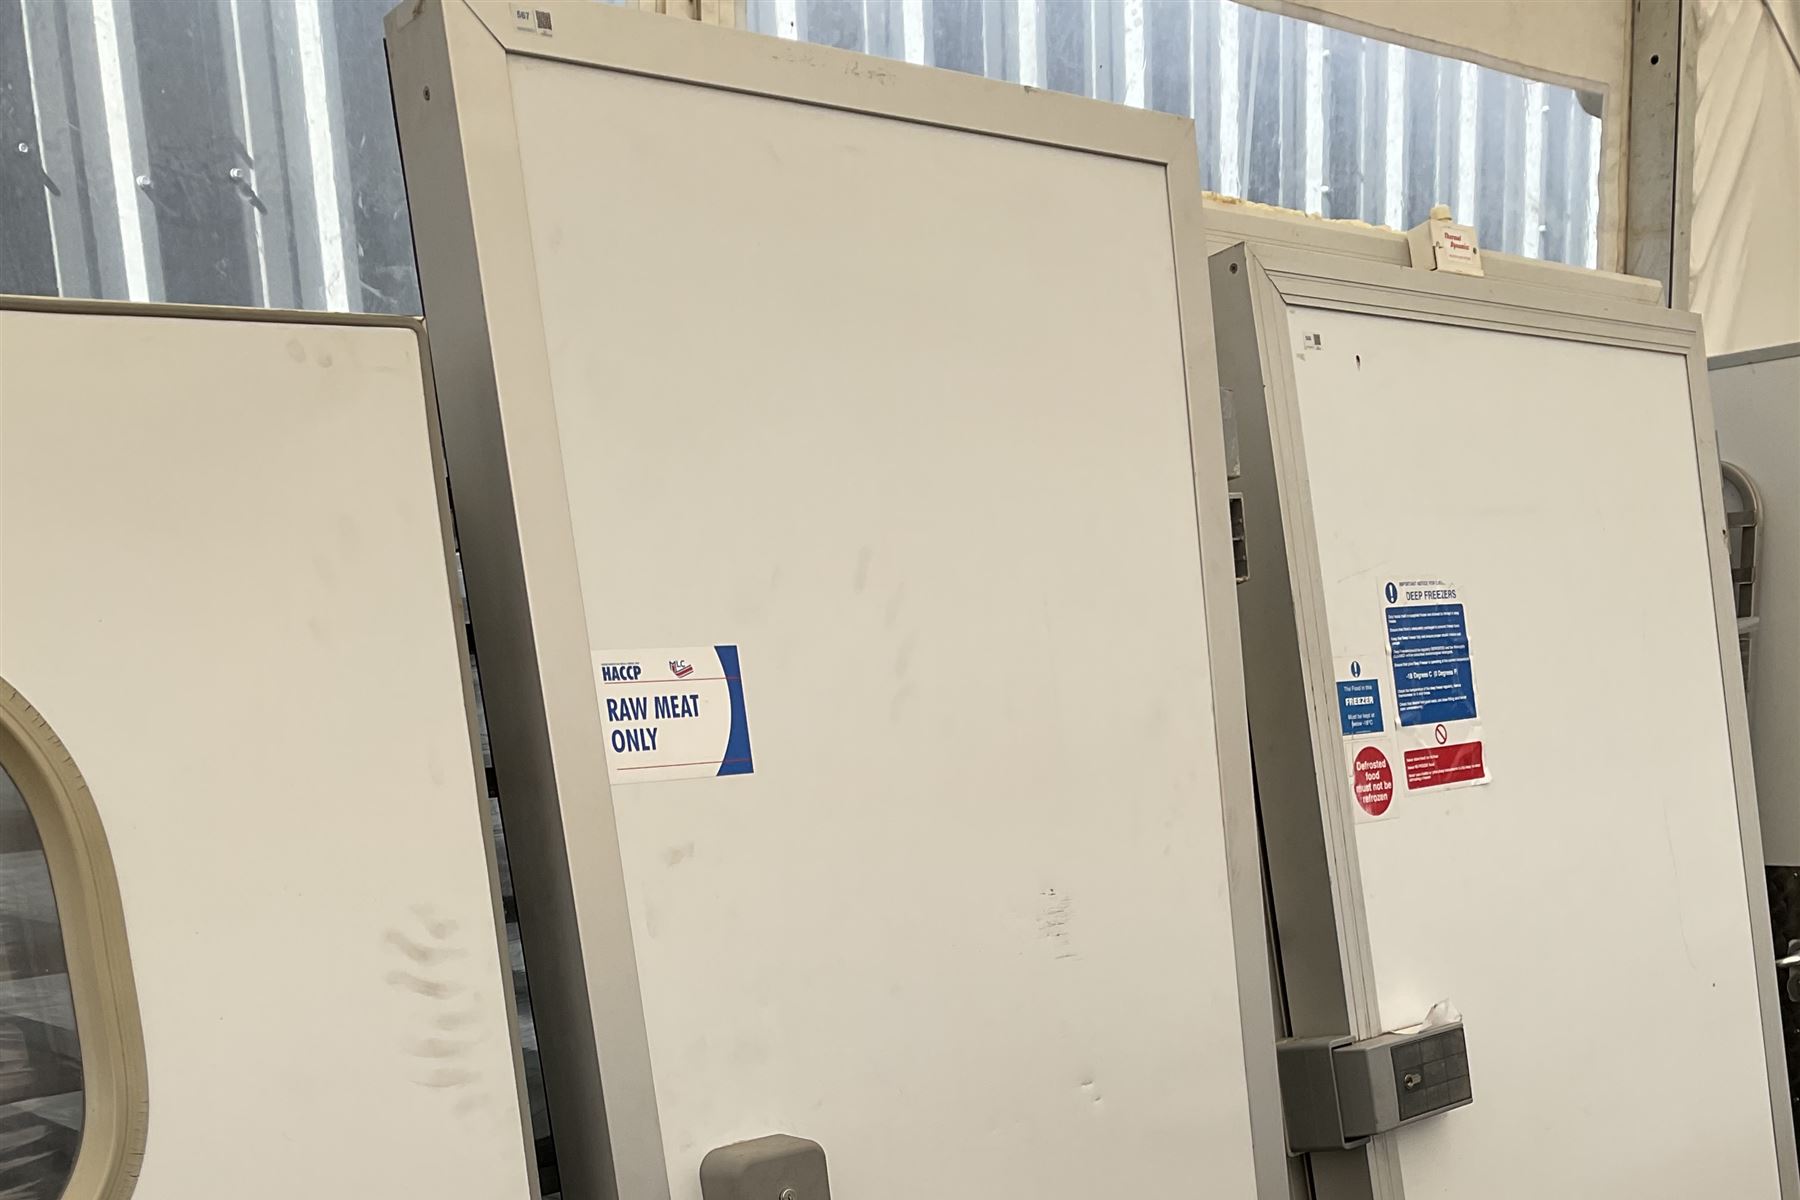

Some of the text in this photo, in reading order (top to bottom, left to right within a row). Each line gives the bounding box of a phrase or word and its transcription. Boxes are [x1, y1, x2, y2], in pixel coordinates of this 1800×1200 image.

[1406, 589, 1457, 601] DEEP FREEZERS
[601, 665, 642, 681] HACCP
[1413, 671, 1429, 680] Degrees
[1438, 669, 1453, 678] Degrees
[1345, 696, 1374, 706] FREEZER
[606, 694, 699, 722] RAW MEAT
[611, 727, 658, 753] ONLY
[1356, 759, 1387, 771] Defrosted
[1365, 770, 1380, 781] food
[1356, 780, 1392, 793] must not be
[1362, 793, 1389, 803] refrozen
